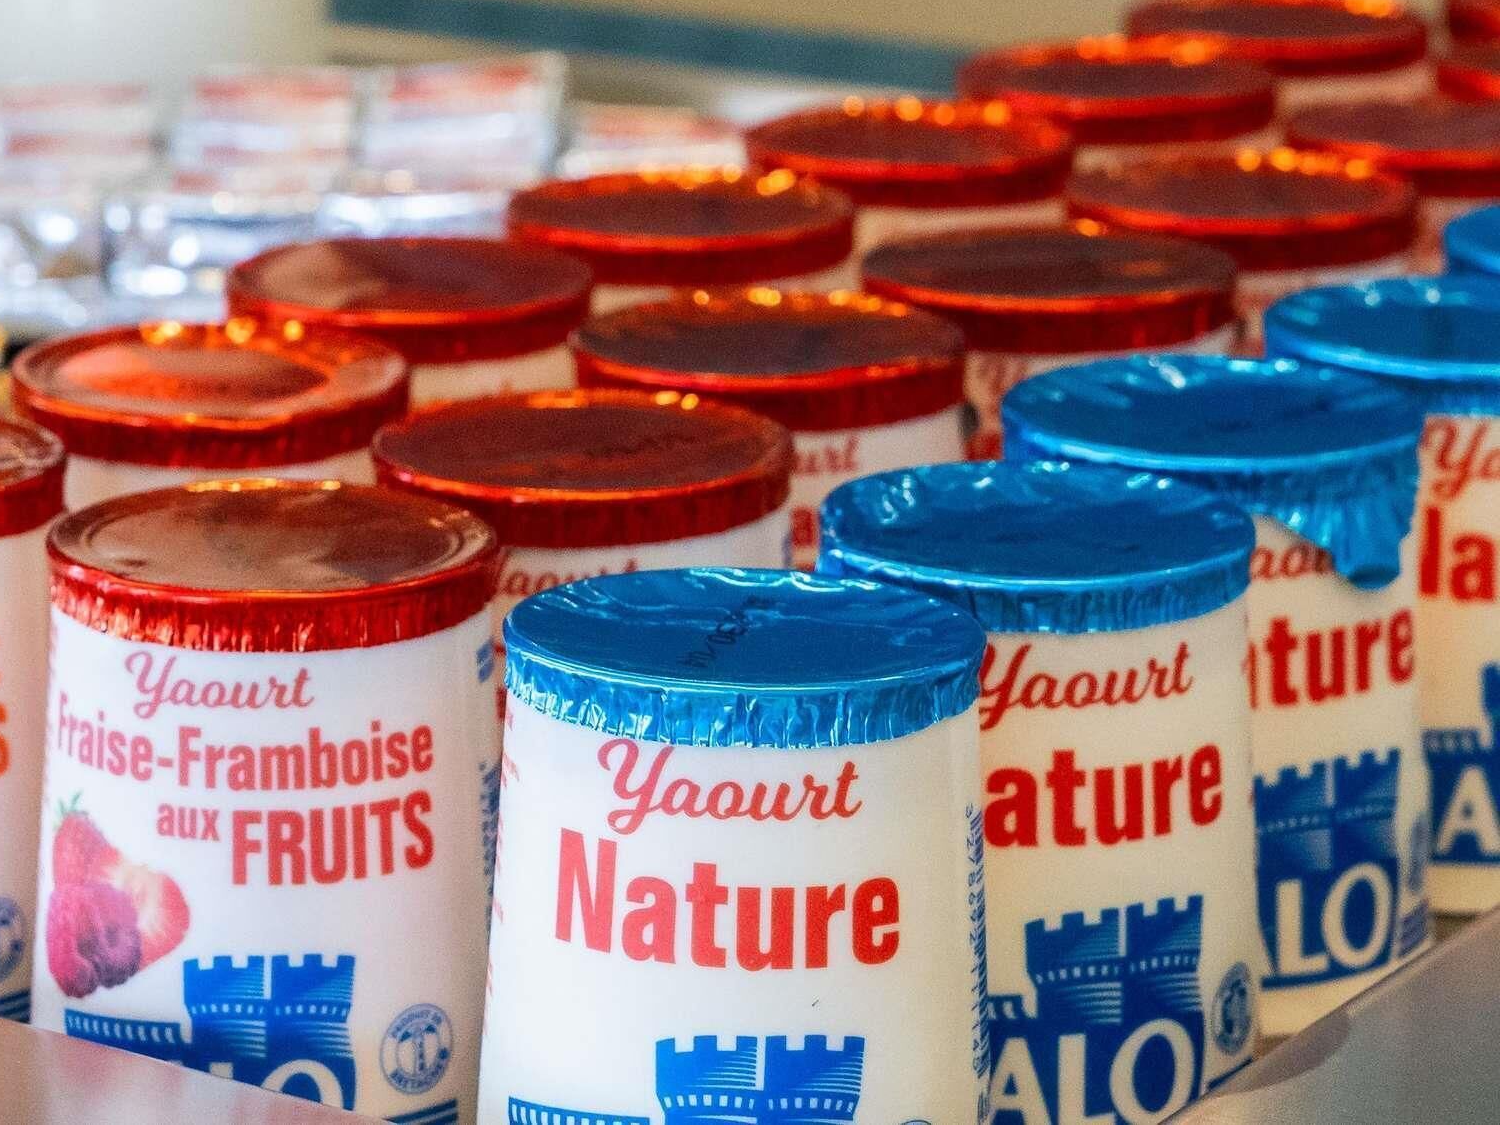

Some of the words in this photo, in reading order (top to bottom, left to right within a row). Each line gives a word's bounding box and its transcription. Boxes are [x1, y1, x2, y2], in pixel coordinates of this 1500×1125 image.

[124, 651, 315, 719] Yaourt
[979, 642, 1193, 731] Yaourt
[1245, 608, 1414, 711] ture
[57, 691, 434, 791] Fraise-Framboise
[597, 738, 863, 835] Yaourt
[156, 803, 221, 842] aux
[232, 790, 434, 886] FRUITS
[984, 744, 1222, 848] ature
[555, 827, 900, 972] Nature
[1276, 862, 1392, 973] LO
[988, 1018, 1195, 1125] ALO
